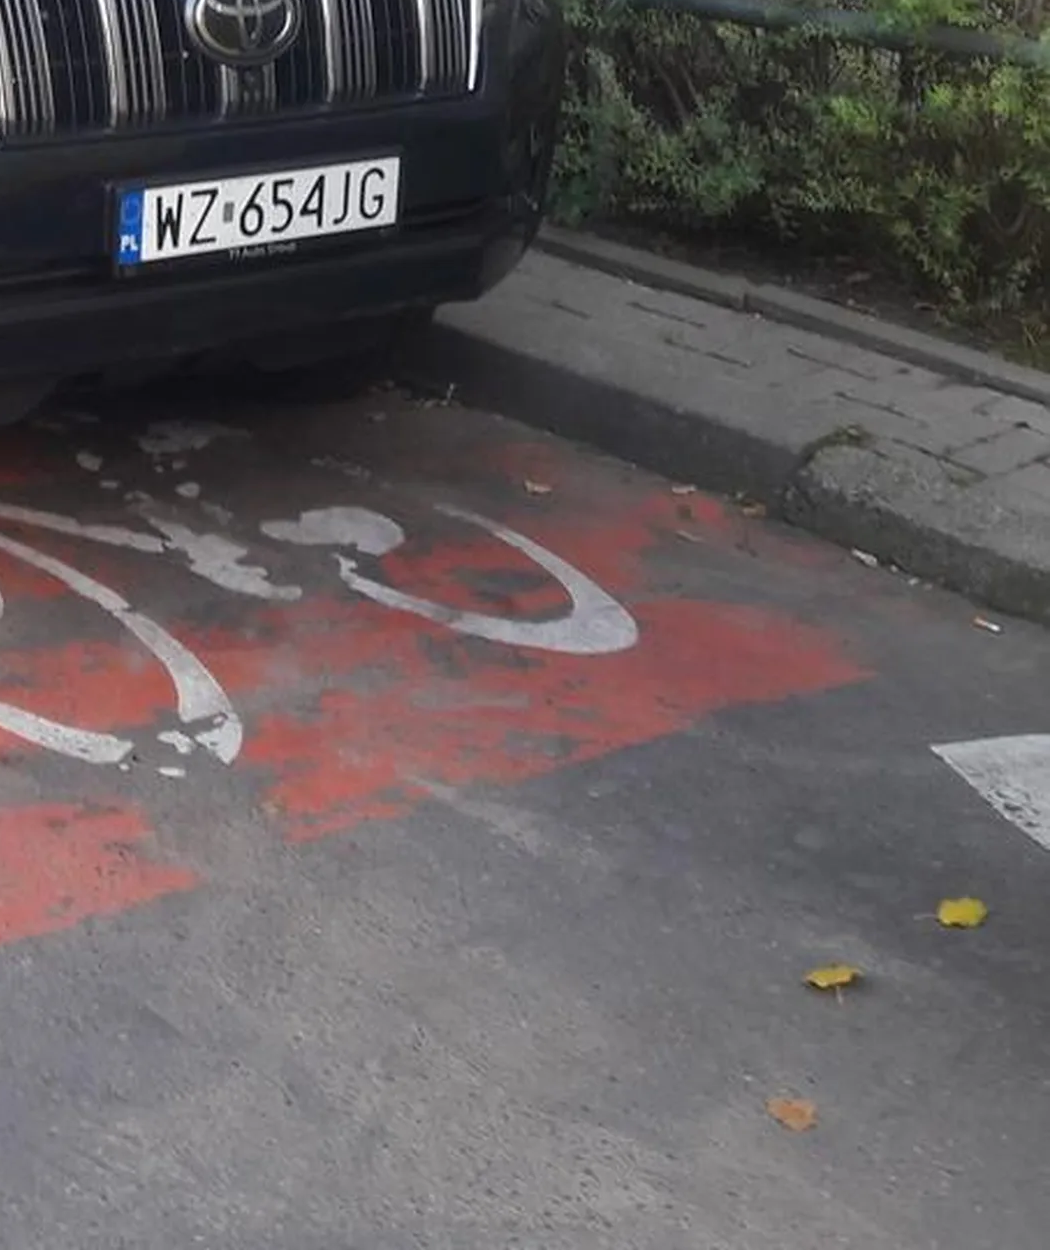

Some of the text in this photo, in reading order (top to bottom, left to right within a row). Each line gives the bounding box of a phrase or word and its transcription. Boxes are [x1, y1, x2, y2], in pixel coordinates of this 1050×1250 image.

[155, 167, 386, 252] WZ 654JG
[121, 234, 139, 252] PL
